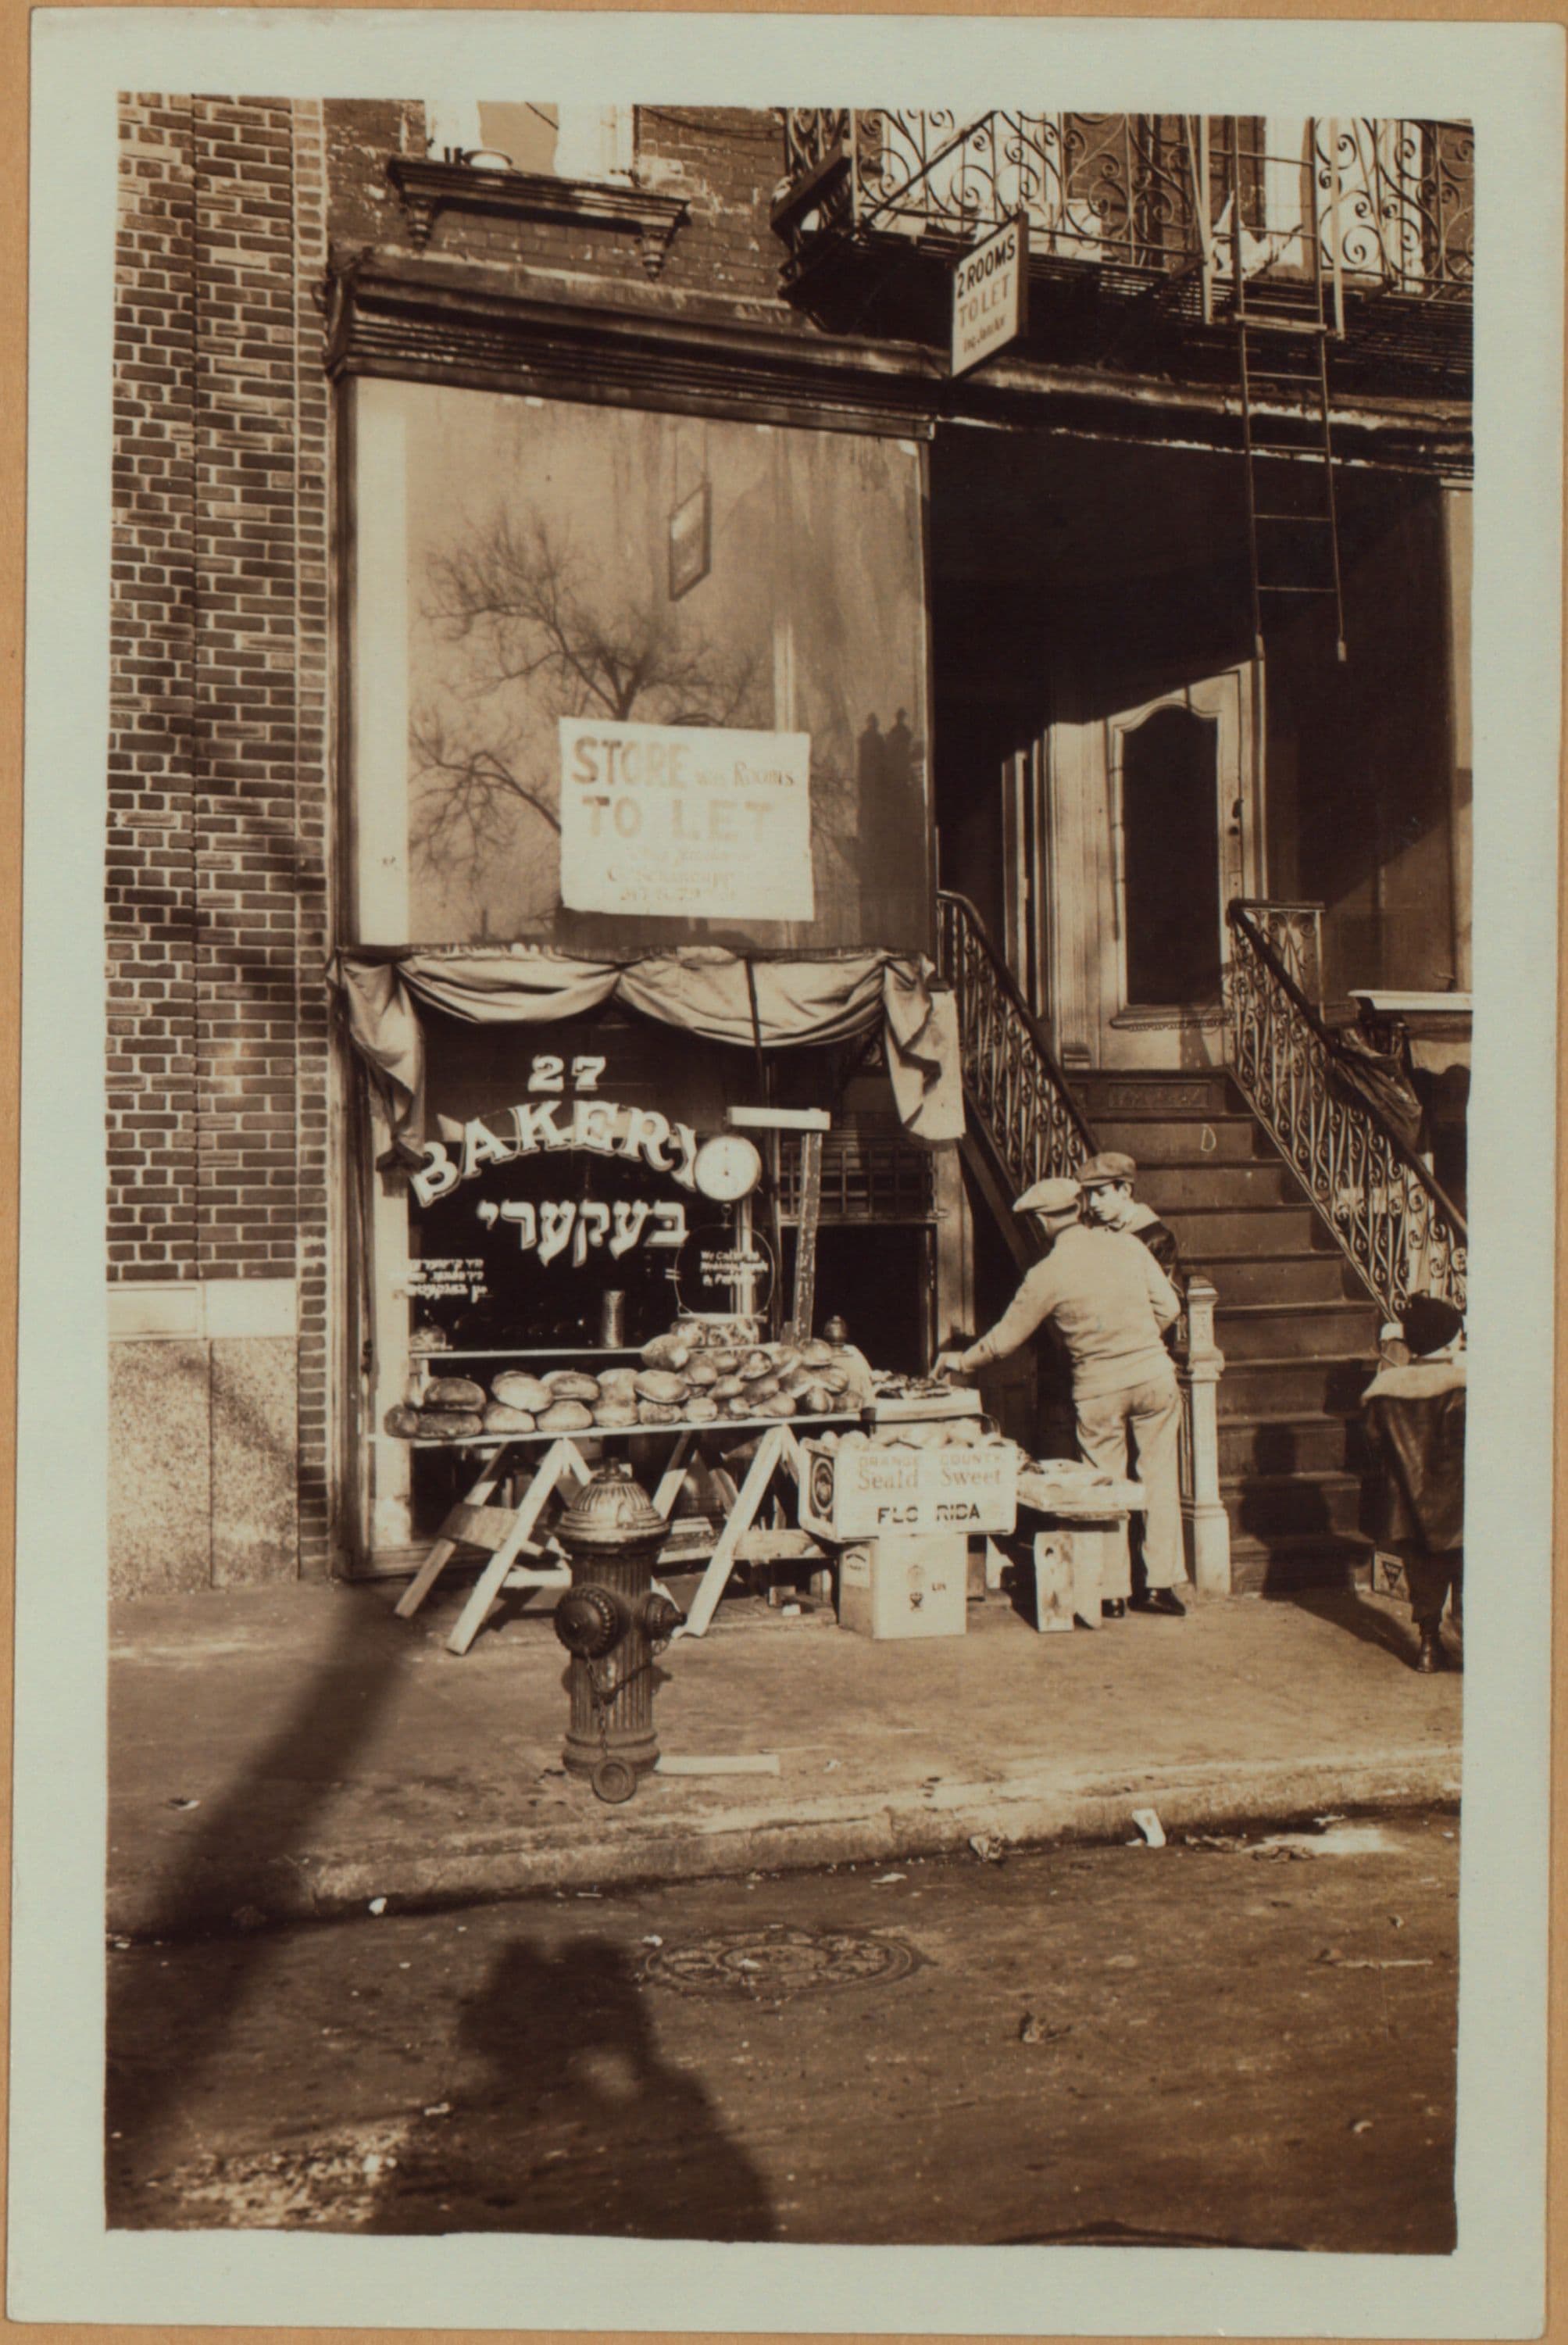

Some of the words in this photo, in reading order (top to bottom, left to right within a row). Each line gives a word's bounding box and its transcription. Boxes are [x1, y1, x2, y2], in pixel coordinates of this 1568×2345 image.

[956, 272, 966, 299] 2
[966, 234, 1015, 291] ROOMS
[958, 296, 978, 329] TO
[981, 273, 1012, 313] LET
[572, 735, 690, 788] STORE
[581, 795, 644, 839] TO
[670, 799, 777, 842] LET
[527, 1055, 607, 1092] 27
[409, 1099, 698, 1208] BAKERY
[477, 1199, 691, 1269] בעקערי
[858, 1467, 920, 1491] Seald
[940, 1467, 1001, 1487] Sweet
[935, 1500, 982, 1522] RIDA
